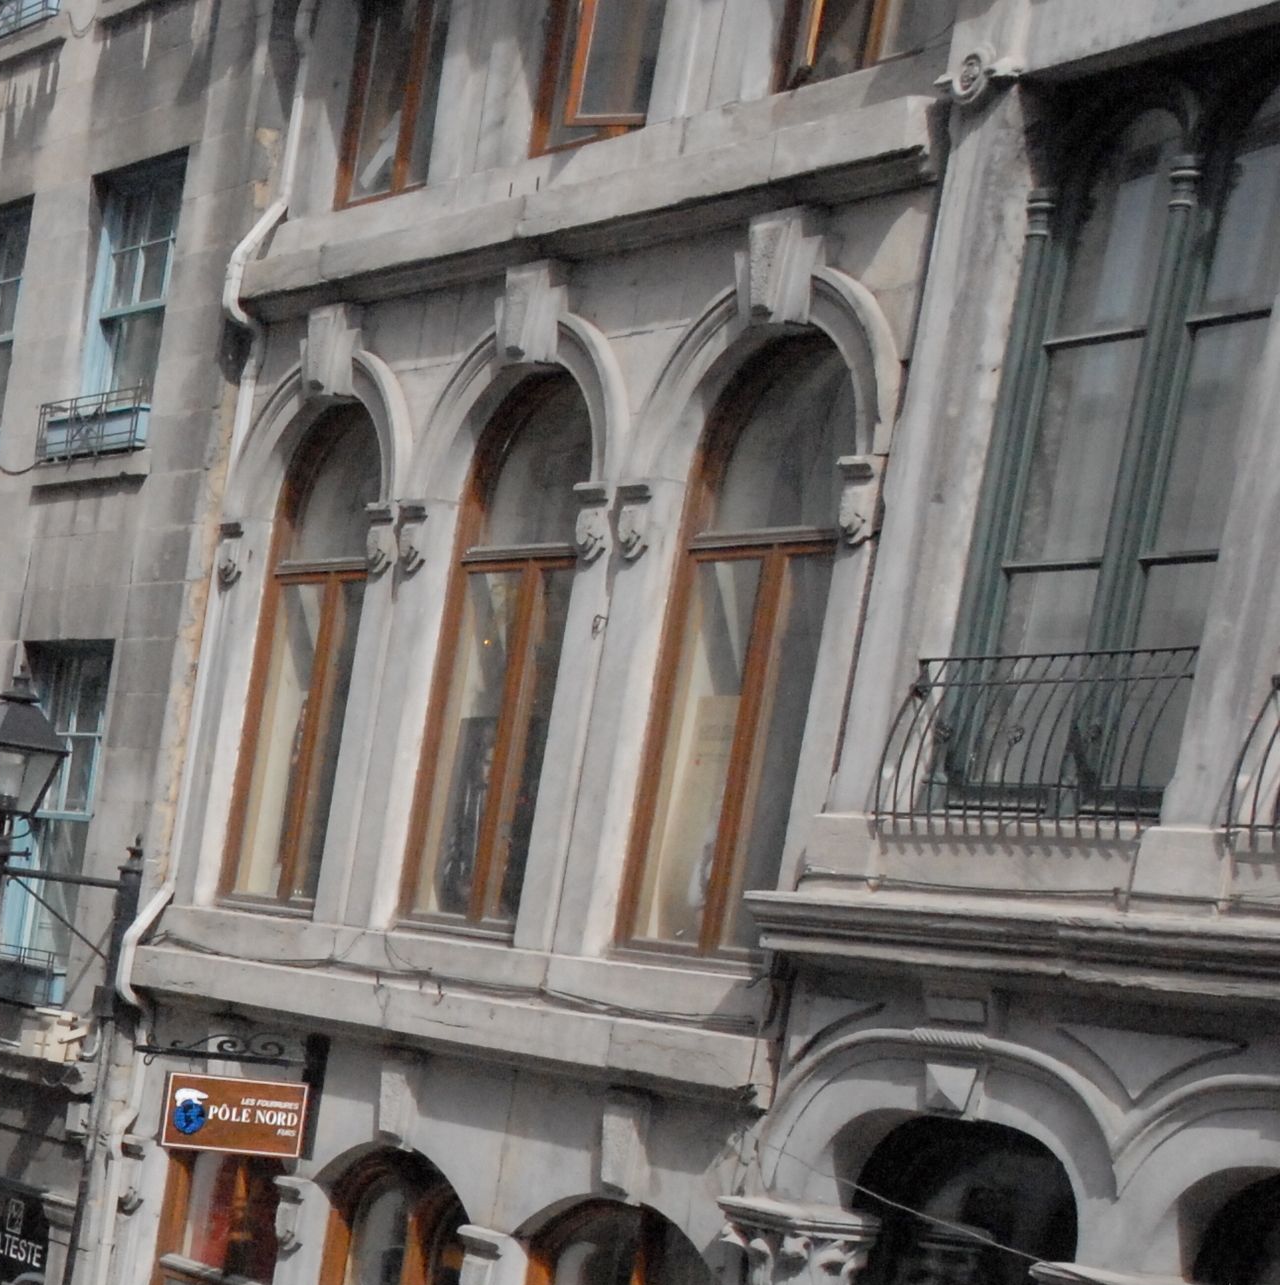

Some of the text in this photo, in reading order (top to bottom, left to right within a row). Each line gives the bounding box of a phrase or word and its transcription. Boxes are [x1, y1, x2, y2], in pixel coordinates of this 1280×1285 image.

[240, 1097, 256, 1106] LES
[208, 1103, 299, 1127] PÔLE NORD
